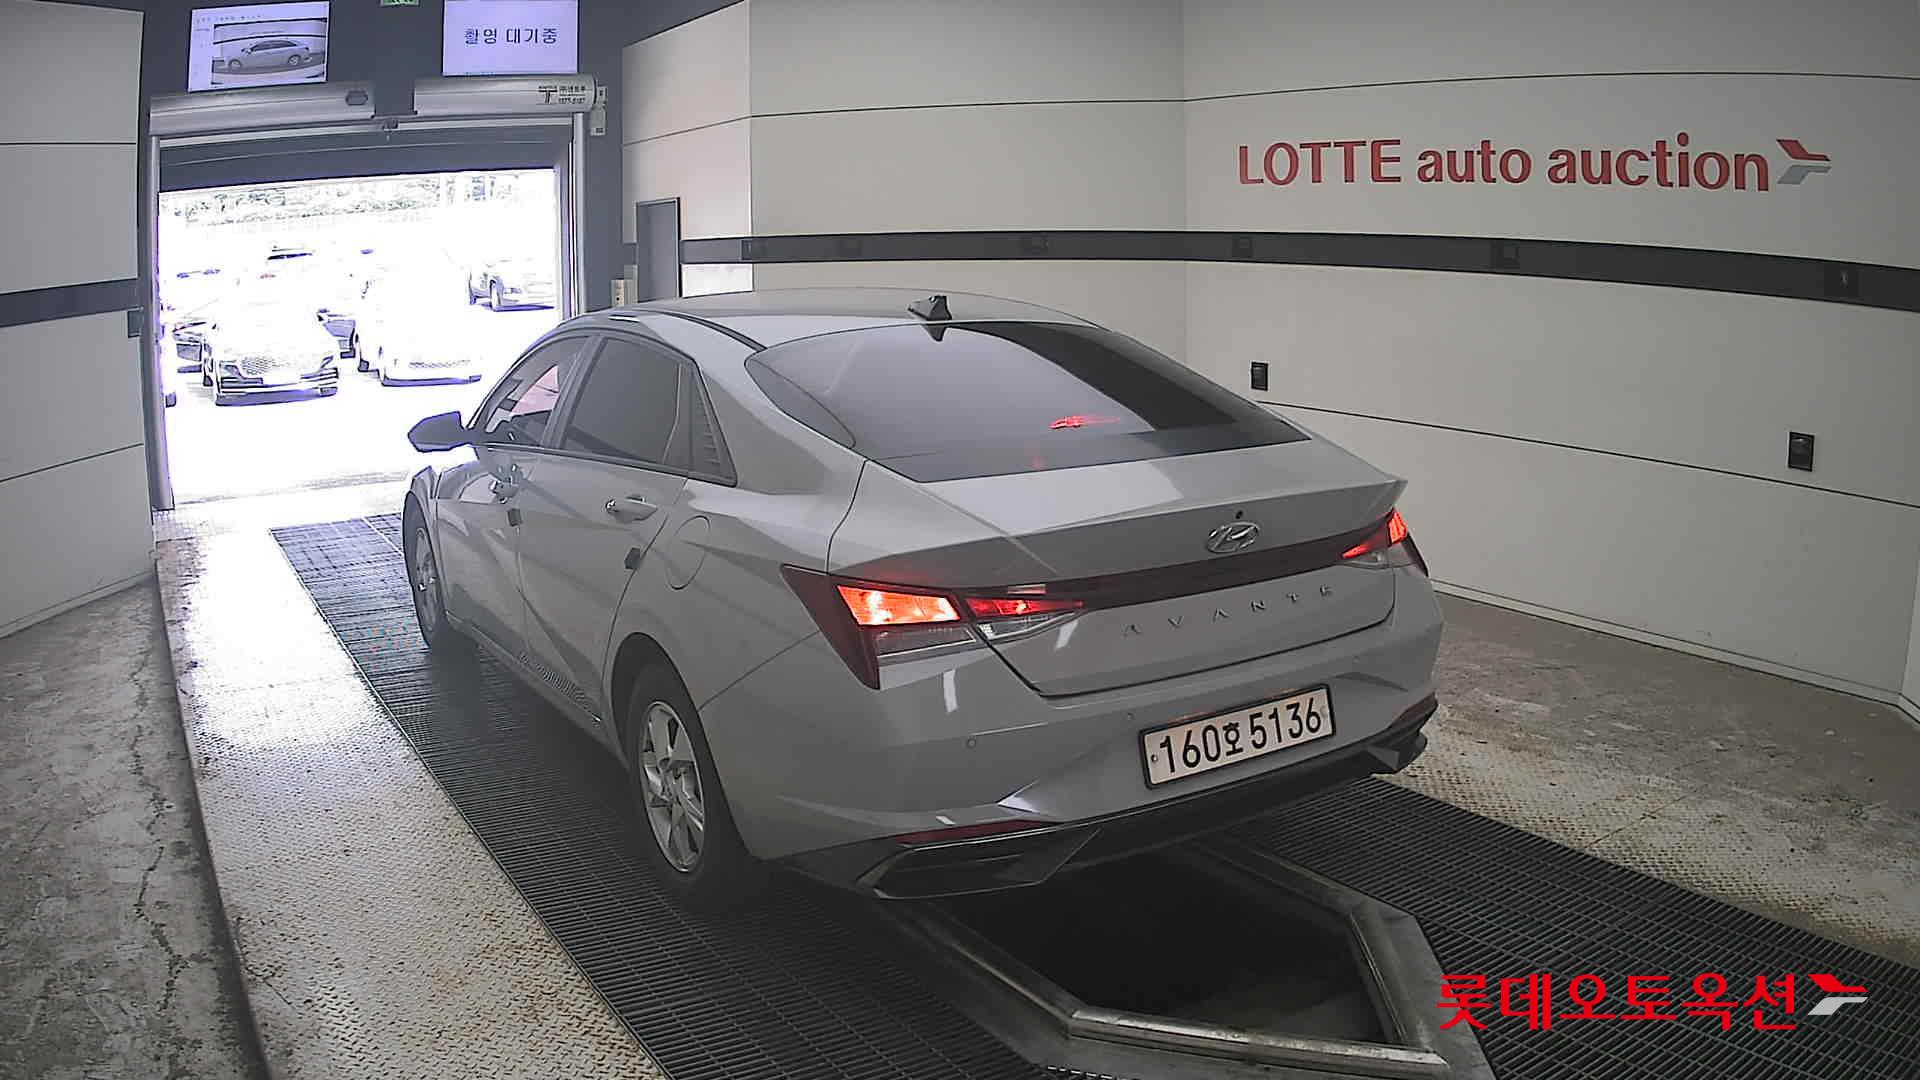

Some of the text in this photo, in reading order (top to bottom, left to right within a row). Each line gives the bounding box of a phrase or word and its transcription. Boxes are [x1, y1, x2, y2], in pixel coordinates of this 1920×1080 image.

[505, 27, 558, 45] 대기중
[1238, 131, 1770, 193] LOTTE auto auction
[1120, 583, 1334, 637] AVANTE
[1247, 696, 1323, 750] 5136
